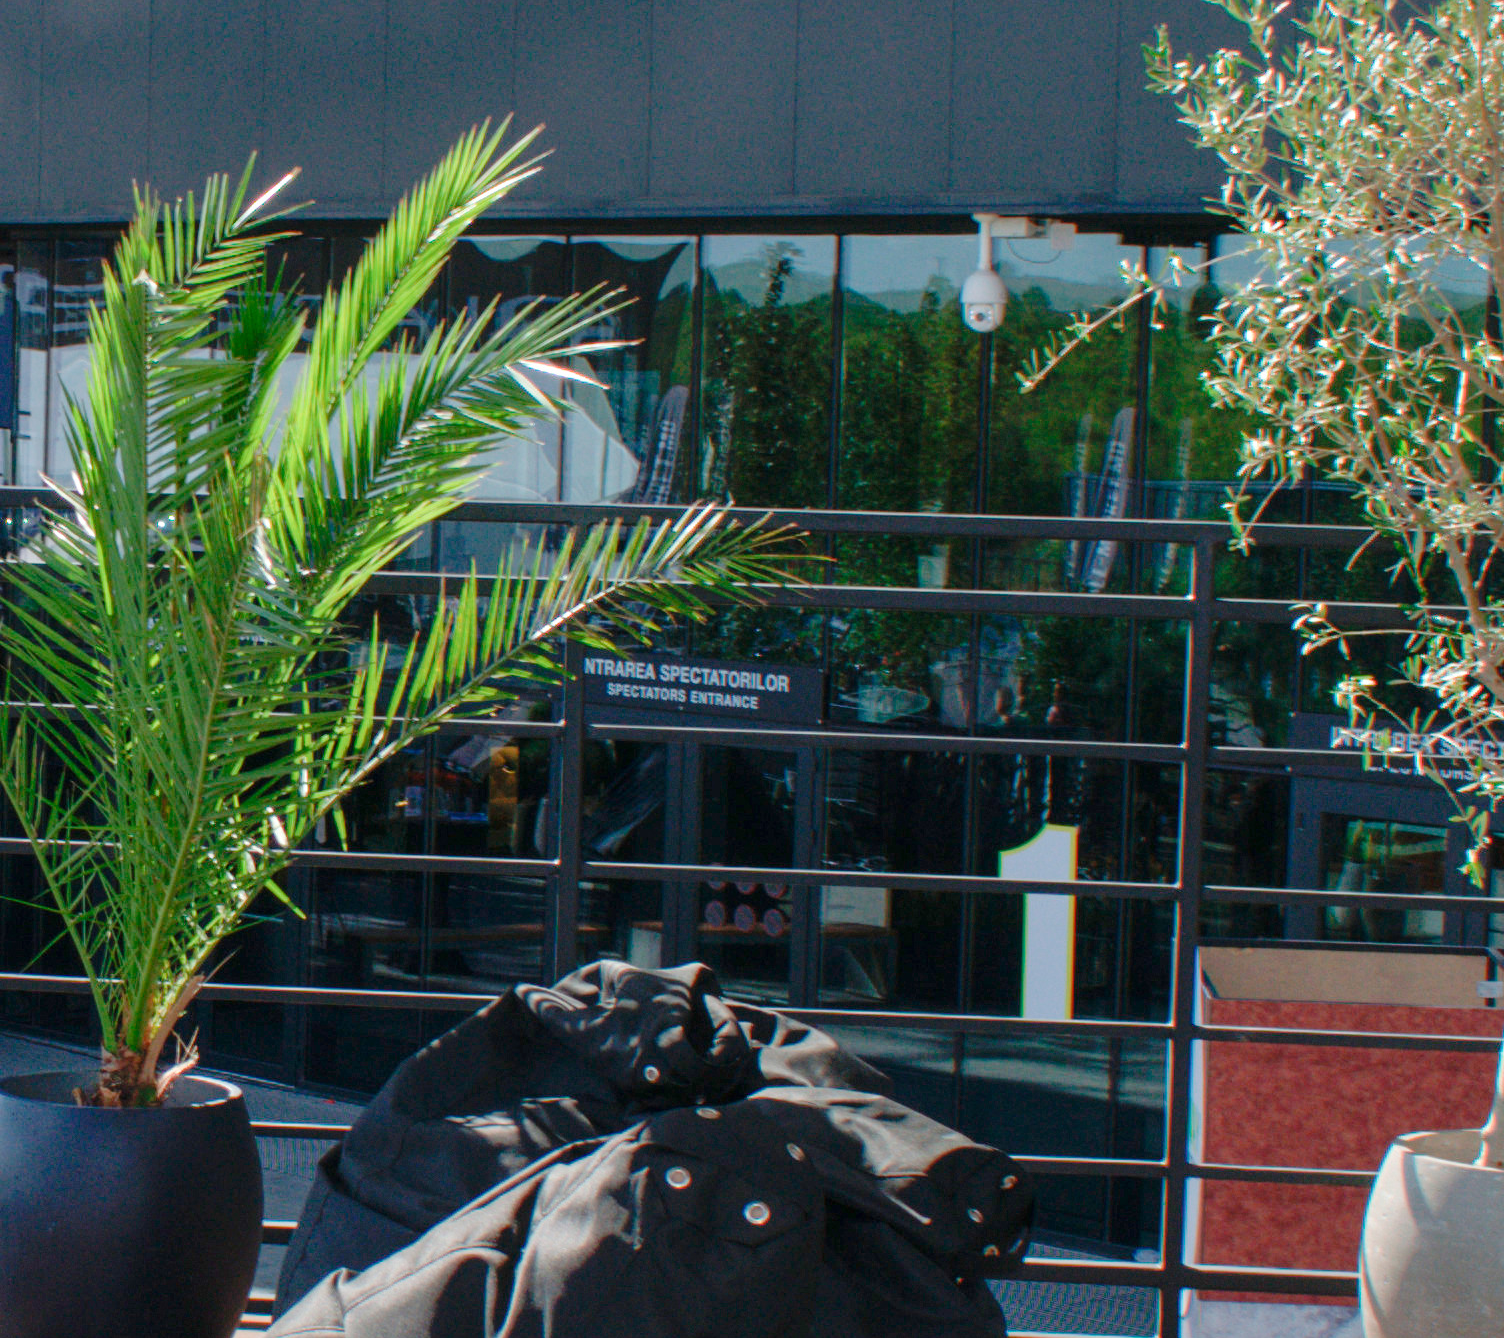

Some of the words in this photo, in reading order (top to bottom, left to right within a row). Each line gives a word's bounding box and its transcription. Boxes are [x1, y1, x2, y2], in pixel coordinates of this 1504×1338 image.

[584, 657, 655, 681] NTRAREA
[659, 662, 790, 693] SPECTATORILOR
[606, 681, 686, 702] SPECTATORS
[690, 689, 759, 710] ENTRANCE
